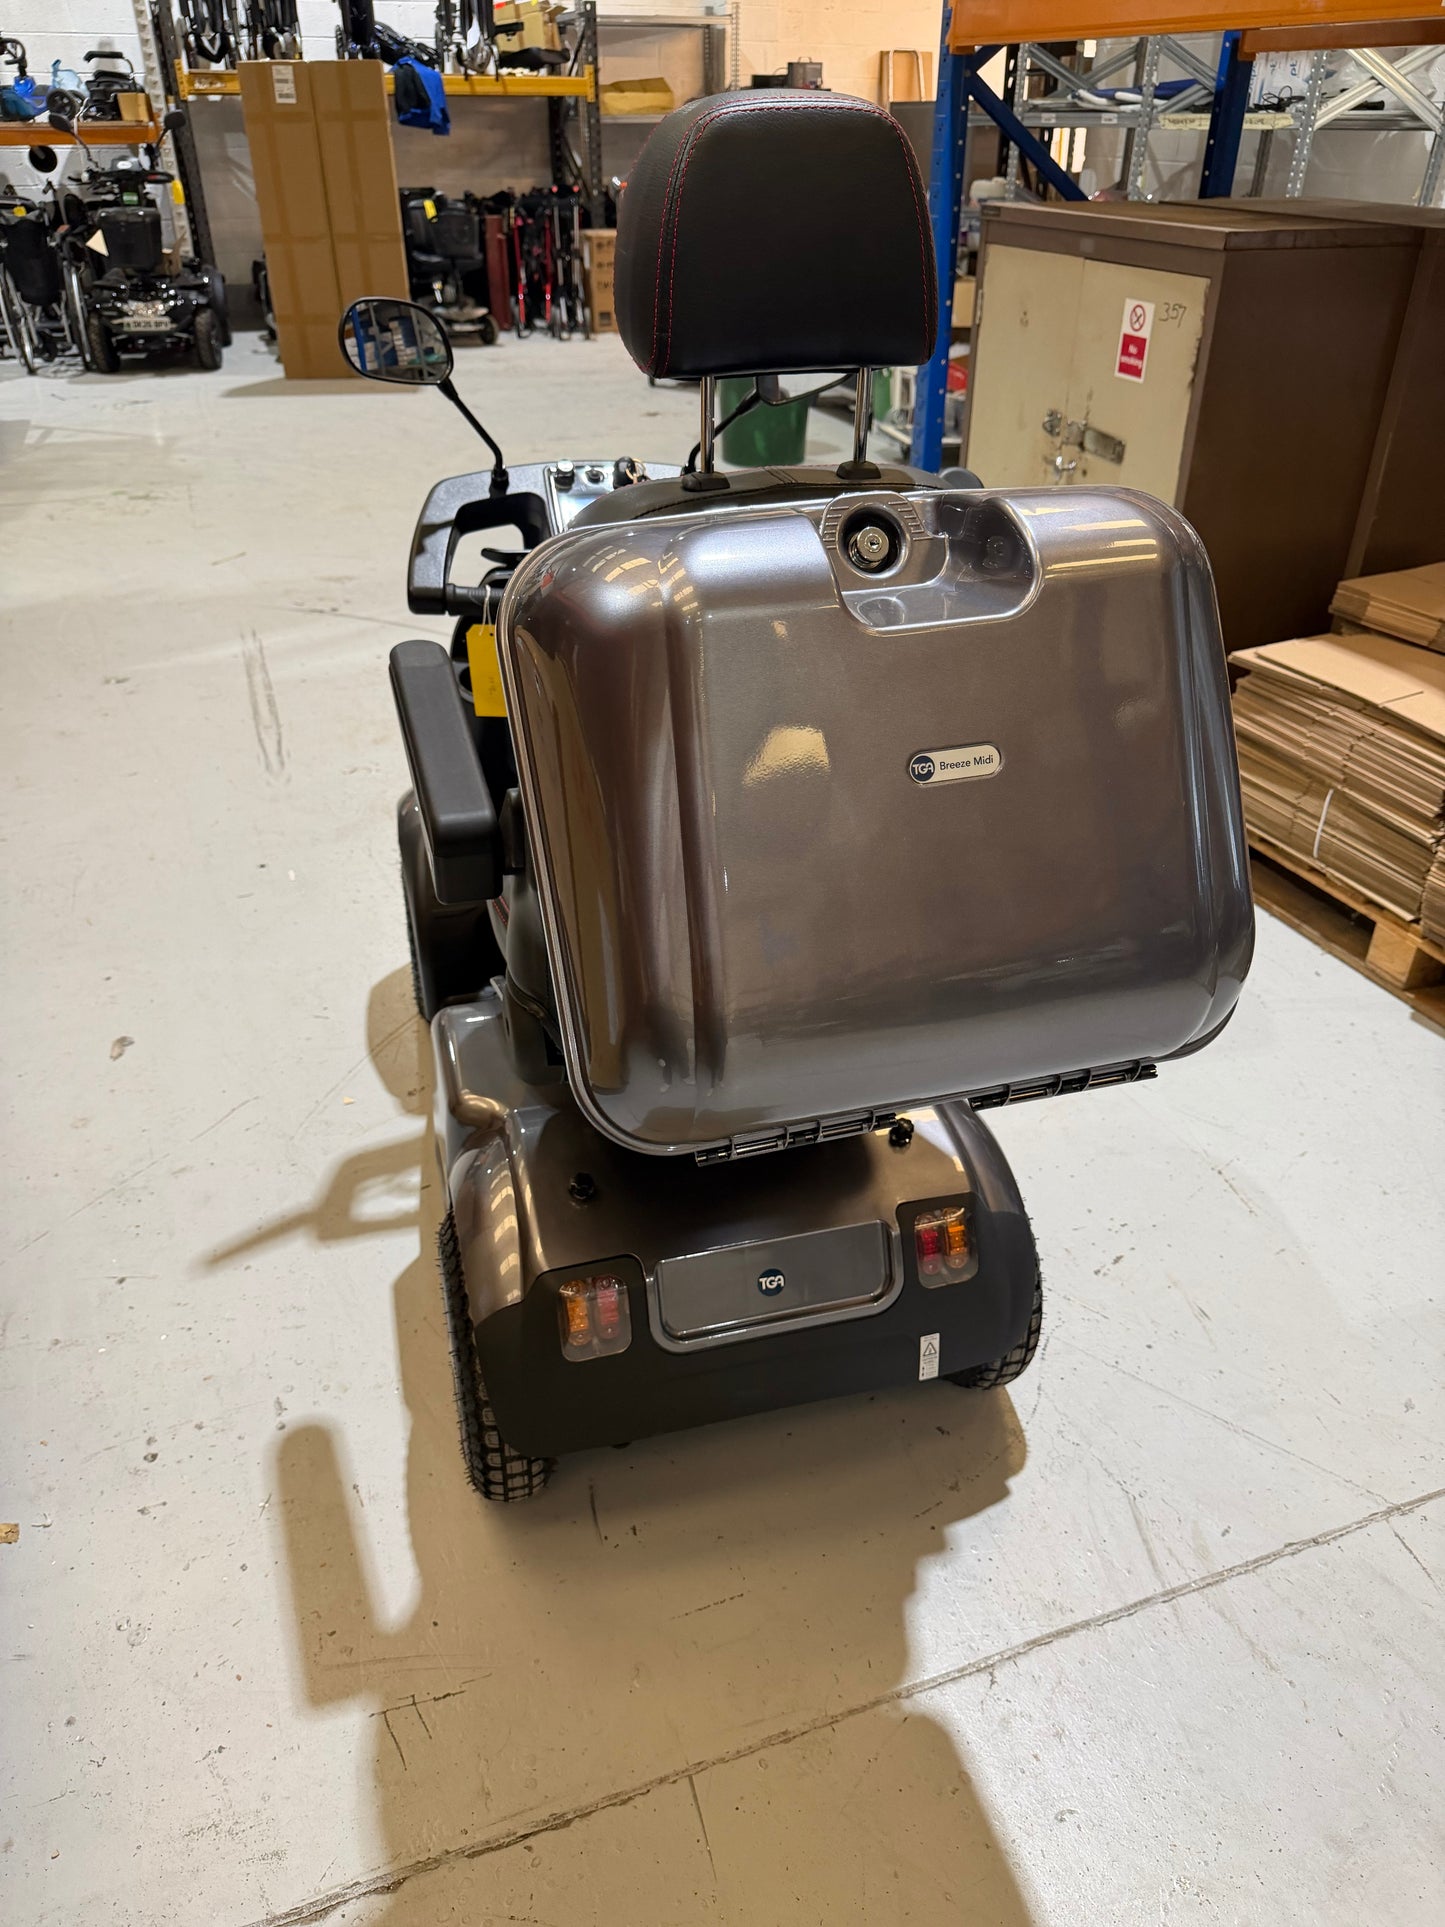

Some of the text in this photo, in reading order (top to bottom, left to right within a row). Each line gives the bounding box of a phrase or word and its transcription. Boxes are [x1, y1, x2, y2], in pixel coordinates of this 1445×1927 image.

[1159, 302, 1187, 328] 357
[1128, 344, 1138, 354] No
[912, 755, 993, 775] TGA Breeze Midi
[759, 1274, 785, 1290] TGA
